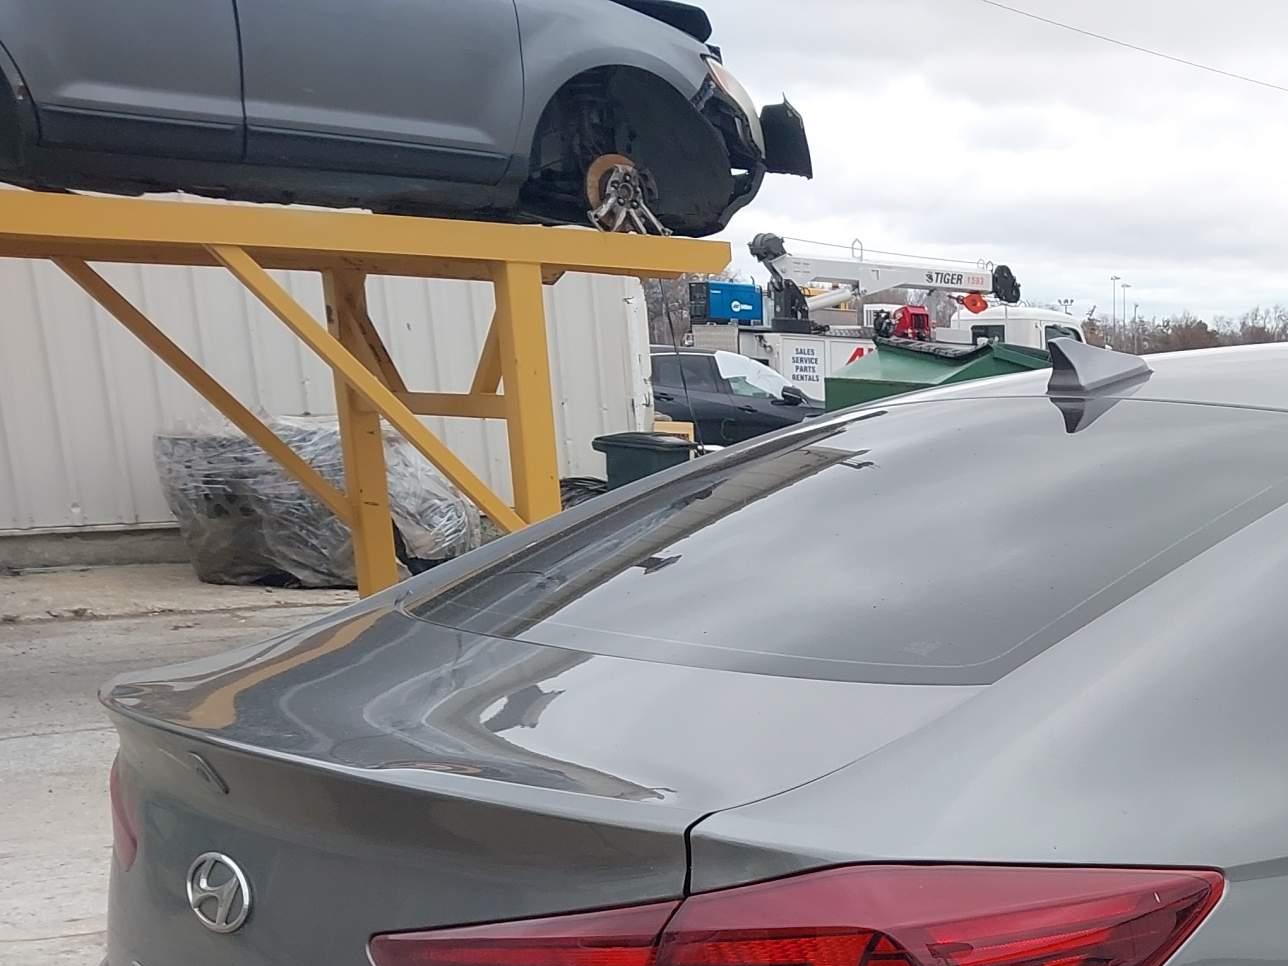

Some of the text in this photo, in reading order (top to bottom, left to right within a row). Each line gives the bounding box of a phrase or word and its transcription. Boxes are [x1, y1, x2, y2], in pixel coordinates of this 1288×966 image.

[935, 272, 963, 285] TIGER
[795, 348, 815, 356] SALES
[792, 356, 818, 365] SERVICE
[795, 365, 816, 373] PARTS
[792, 374, 819, 382] RENTALS
